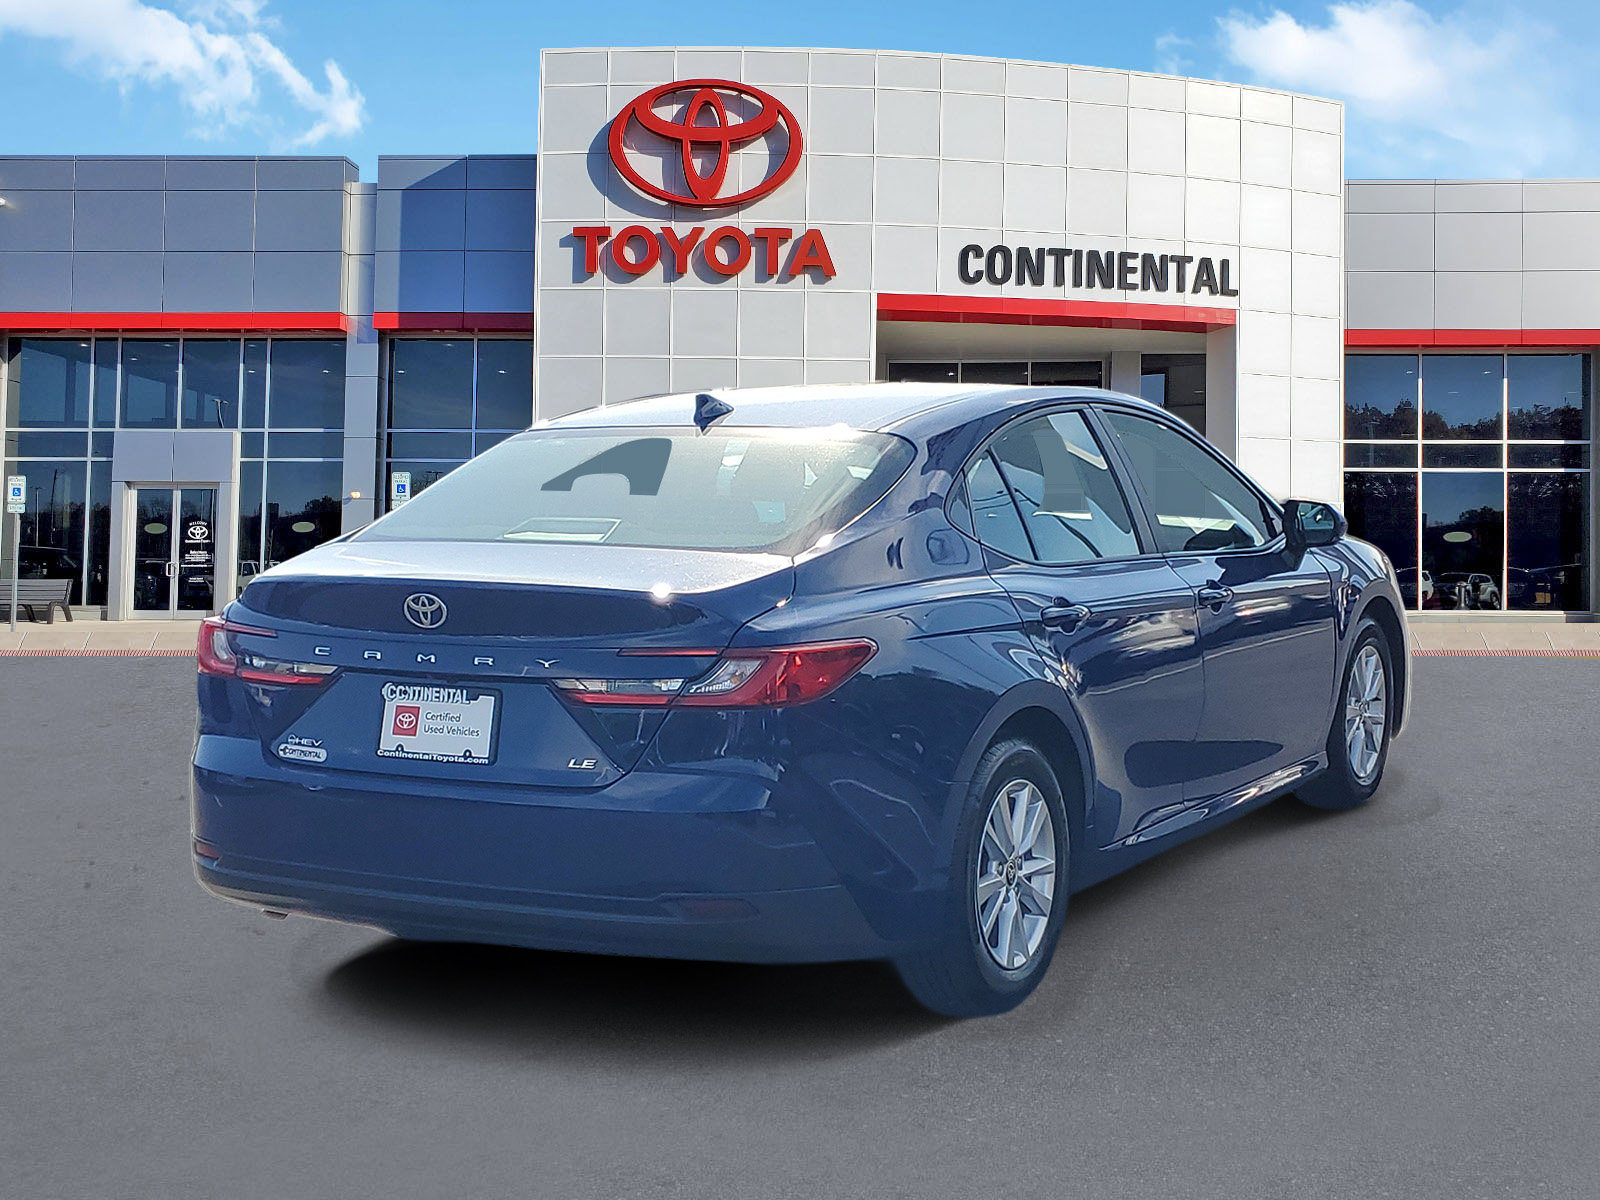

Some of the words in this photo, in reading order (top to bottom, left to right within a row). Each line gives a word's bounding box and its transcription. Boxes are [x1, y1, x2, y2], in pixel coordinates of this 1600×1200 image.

[572, 225, 837, 277] TOYOTA
[958, 244, 1239, 297] CONTINENTAL
[314, 646, 560, 668] CAMRY
[382, 683, 471, 705] CONTINENTAL
[425, 711, 461, 722] Certified
[424, 724, 444, 734] Used
[446, 726, 480, 737] Vehicles
[377, 750, 489, 764] ContinentalToyota.com
[568, 758, 598, 769] LE
